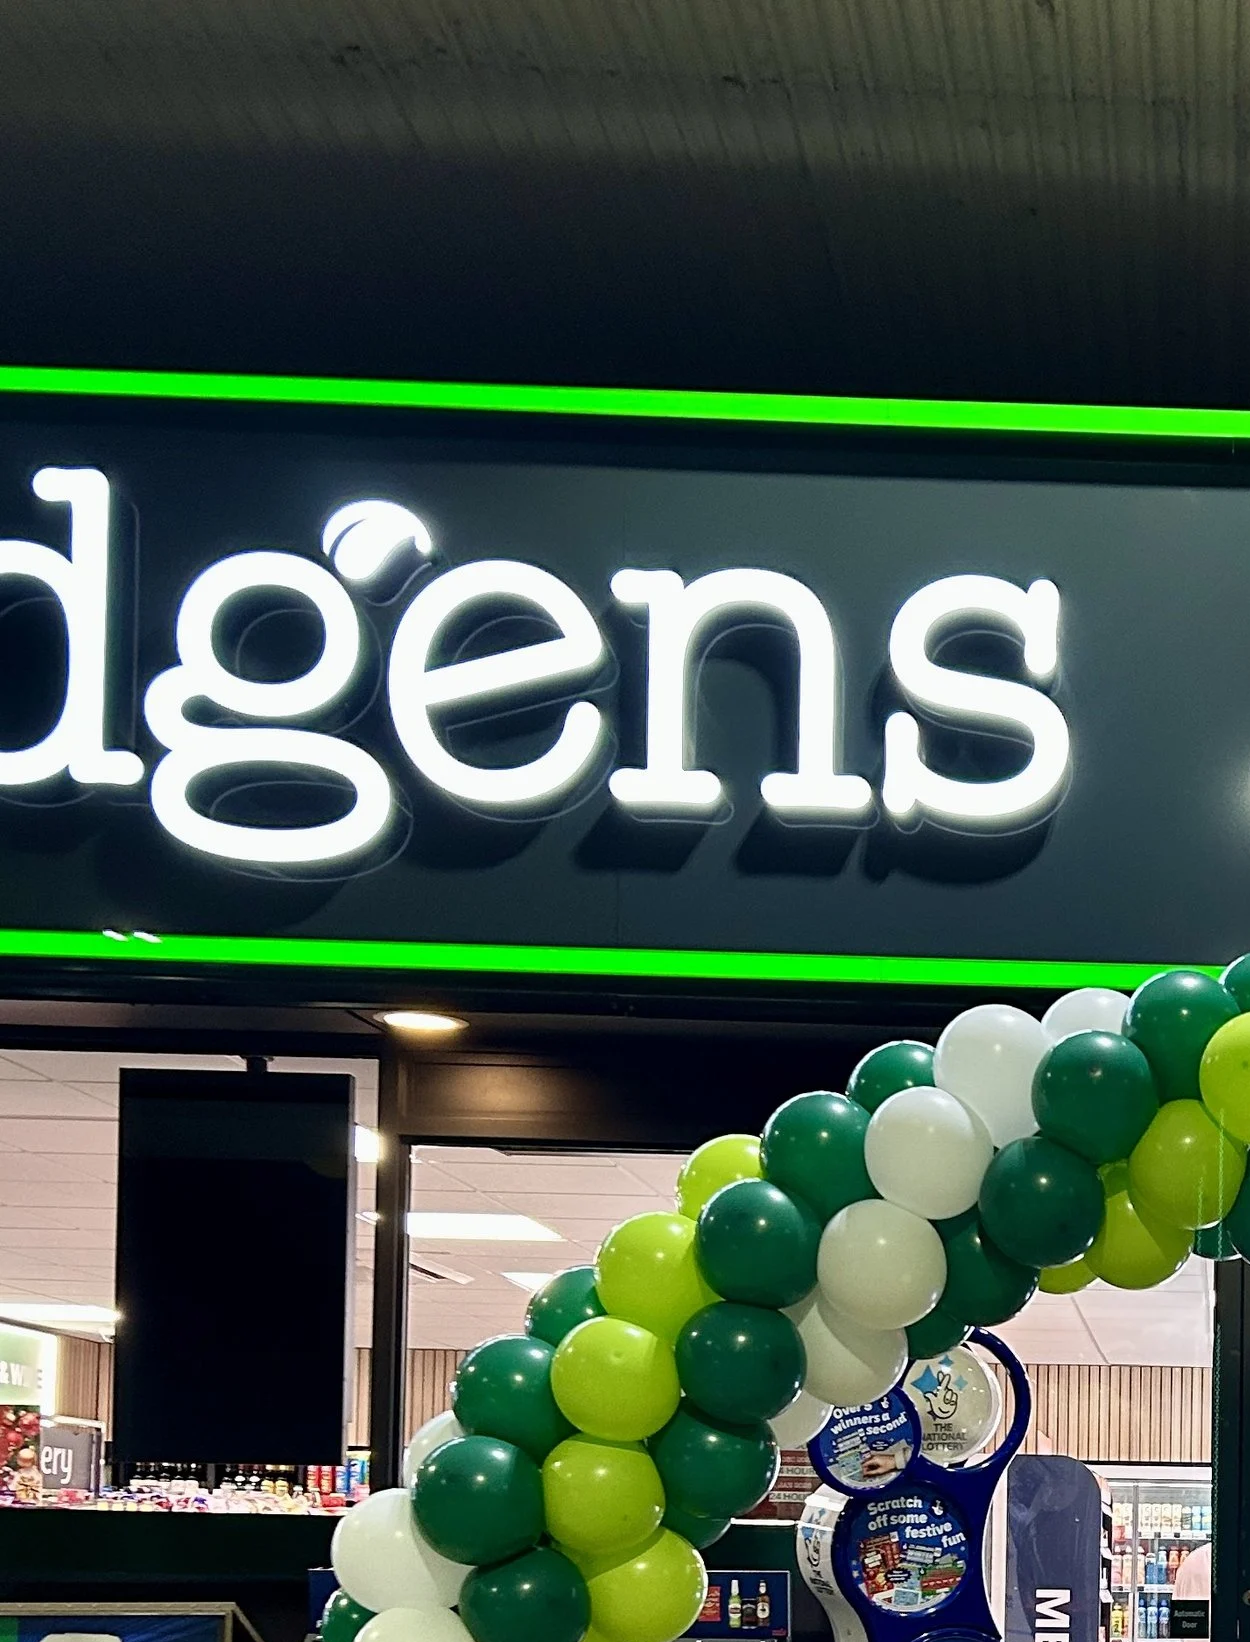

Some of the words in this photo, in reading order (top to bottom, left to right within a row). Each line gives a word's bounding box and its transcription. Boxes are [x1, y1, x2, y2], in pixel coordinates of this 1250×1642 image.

[830, 1413, 881, 1435] winners
[881, 1412, 891, 1422] a
[866, 1411, 908, 1436] second
[933, 1423, 953, 1432] THE
[867, 1496, 923, 1515] Scratch
[868, 1513, 888, 1530] off
[890, 1513, 928, 1525] some
[905, 1522, 953, 1539] festive
[941, 1532, 966, 1548] fun
